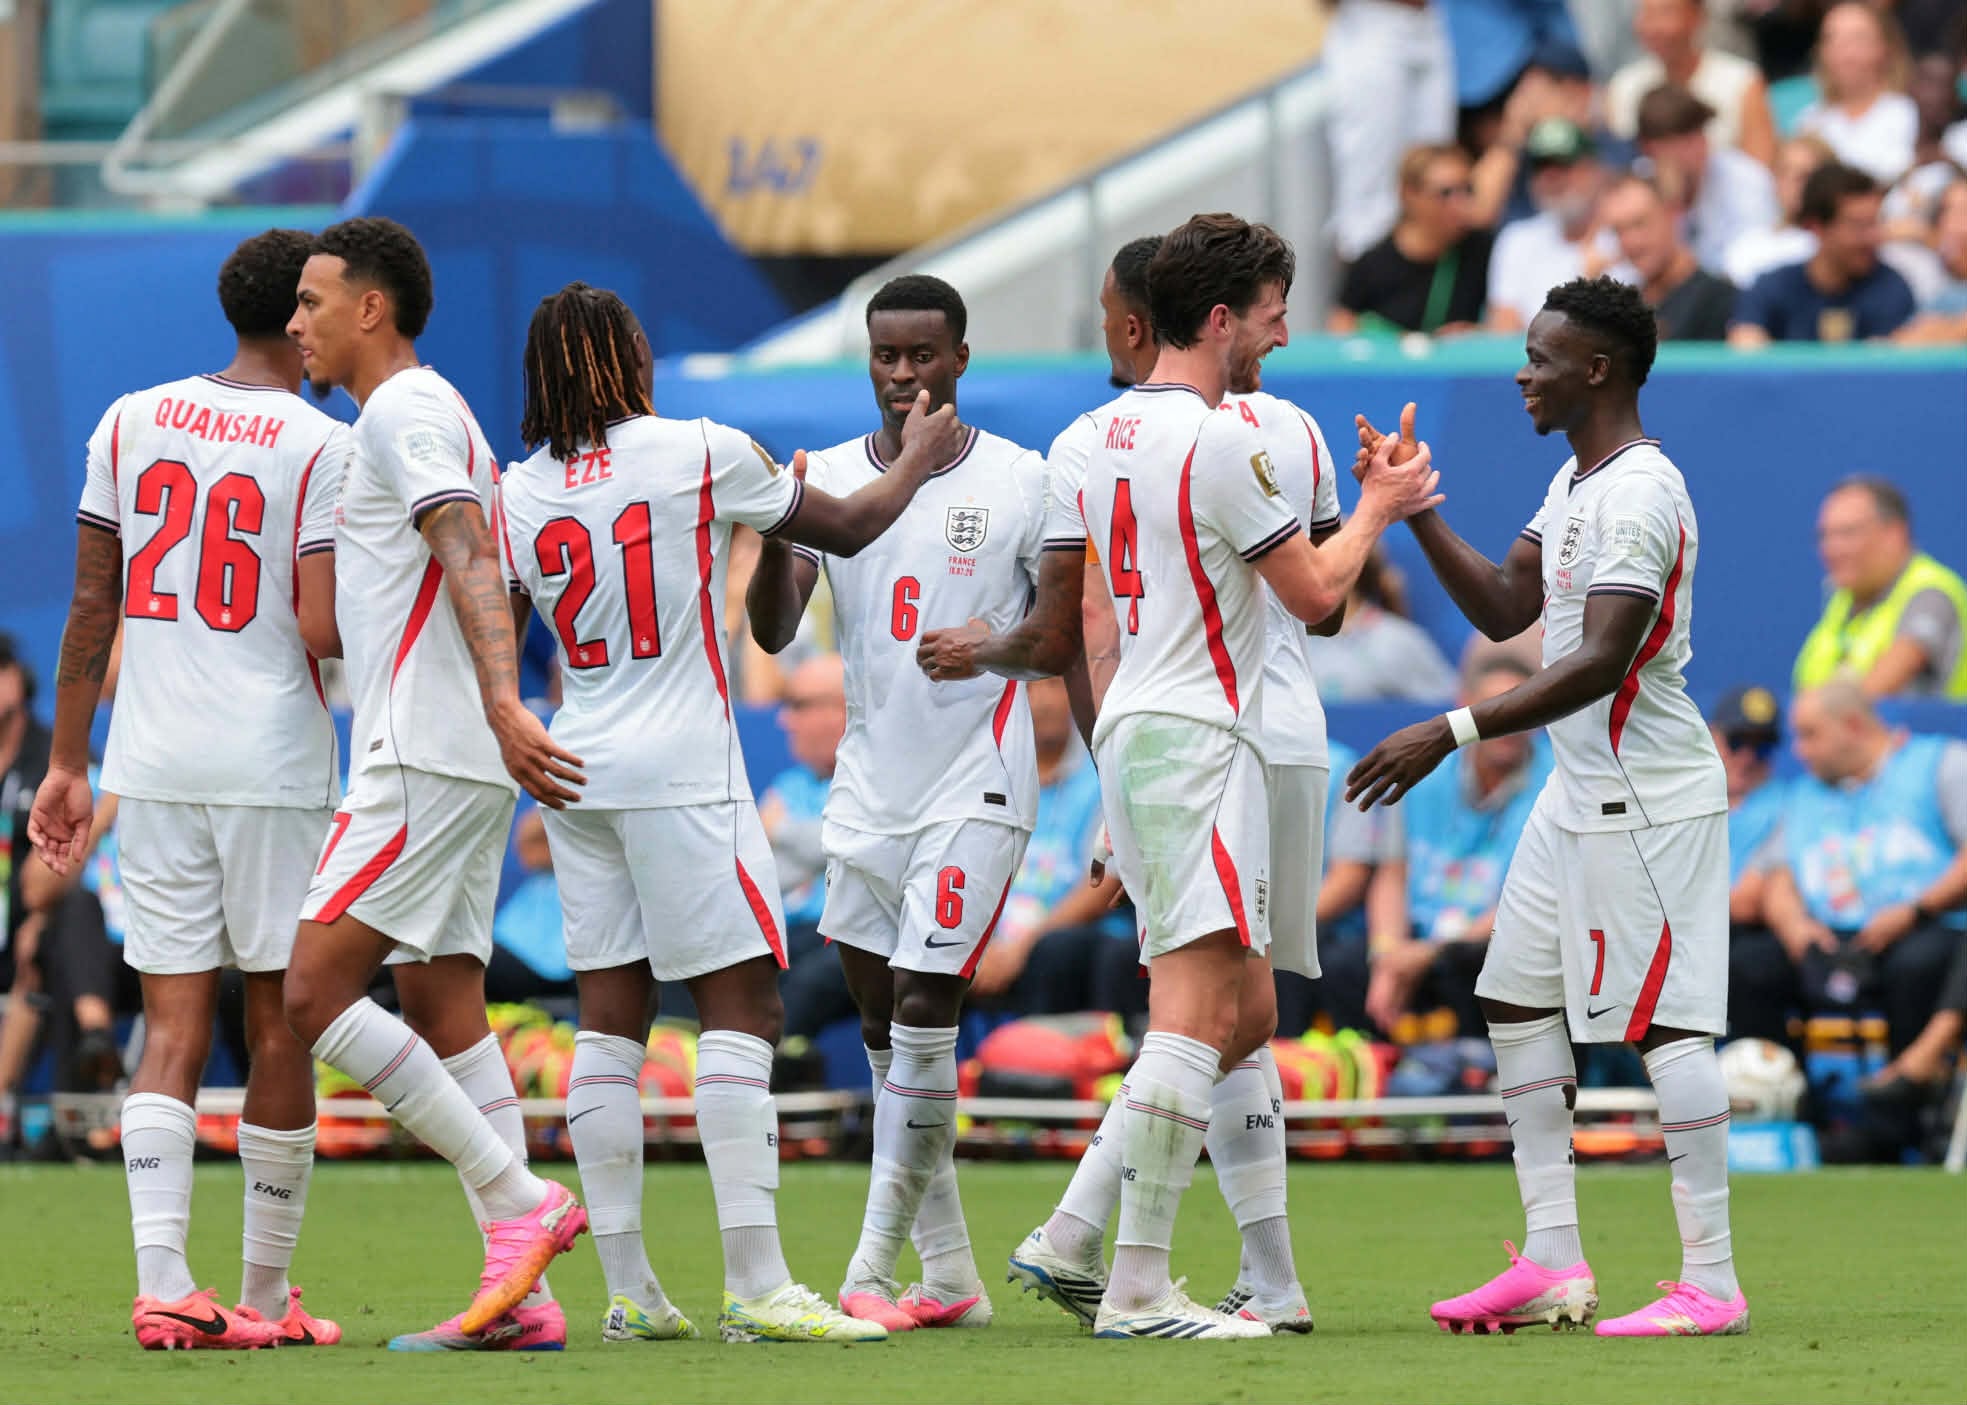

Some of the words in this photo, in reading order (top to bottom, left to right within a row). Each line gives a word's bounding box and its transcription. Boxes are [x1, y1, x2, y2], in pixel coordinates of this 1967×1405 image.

[155, 397, 285, 448] QUANSAH
[1105, 417, 1141, 450] RICE
[565, 448, 613, 489] EZE
[125, 458, 265, 633] 26
[1615, 527, 1641, 538] UNITES
[948, 556, 977, 567] FRANCE
[1109, 478, 1145, 635] 4
[534, 501, 661, 669] 21
[891, 576, 921, 641] 6
[935, 866, 965, 929] 6
[1589, 929, 1606, 996] 7
[1246, 1114, 1275, 1130] ENG
[129, 1157, 161, 1173] ENG
[1121, 1165, 1137, 1181] NG
[253, 1181, 292, 1200] ENG
